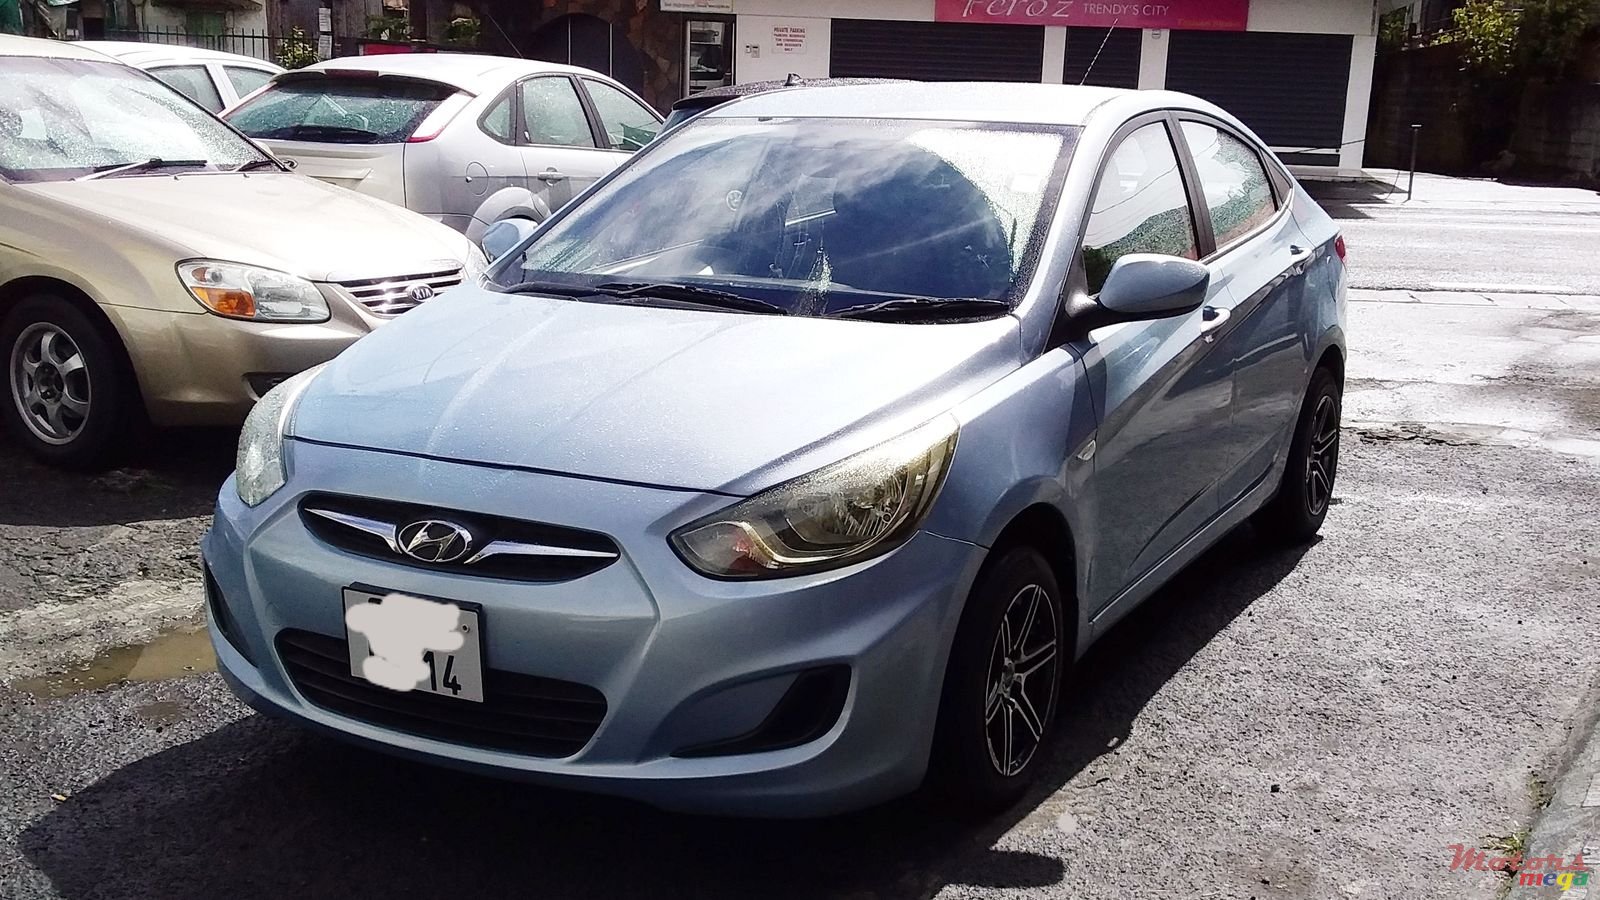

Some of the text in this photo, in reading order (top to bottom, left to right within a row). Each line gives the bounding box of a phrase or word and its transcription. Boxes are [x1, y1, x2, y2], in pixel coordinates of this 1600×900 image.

[1084, 3, 1169, 16] TRENDY'S CITY
[412, 286, 432, 300] KIA
